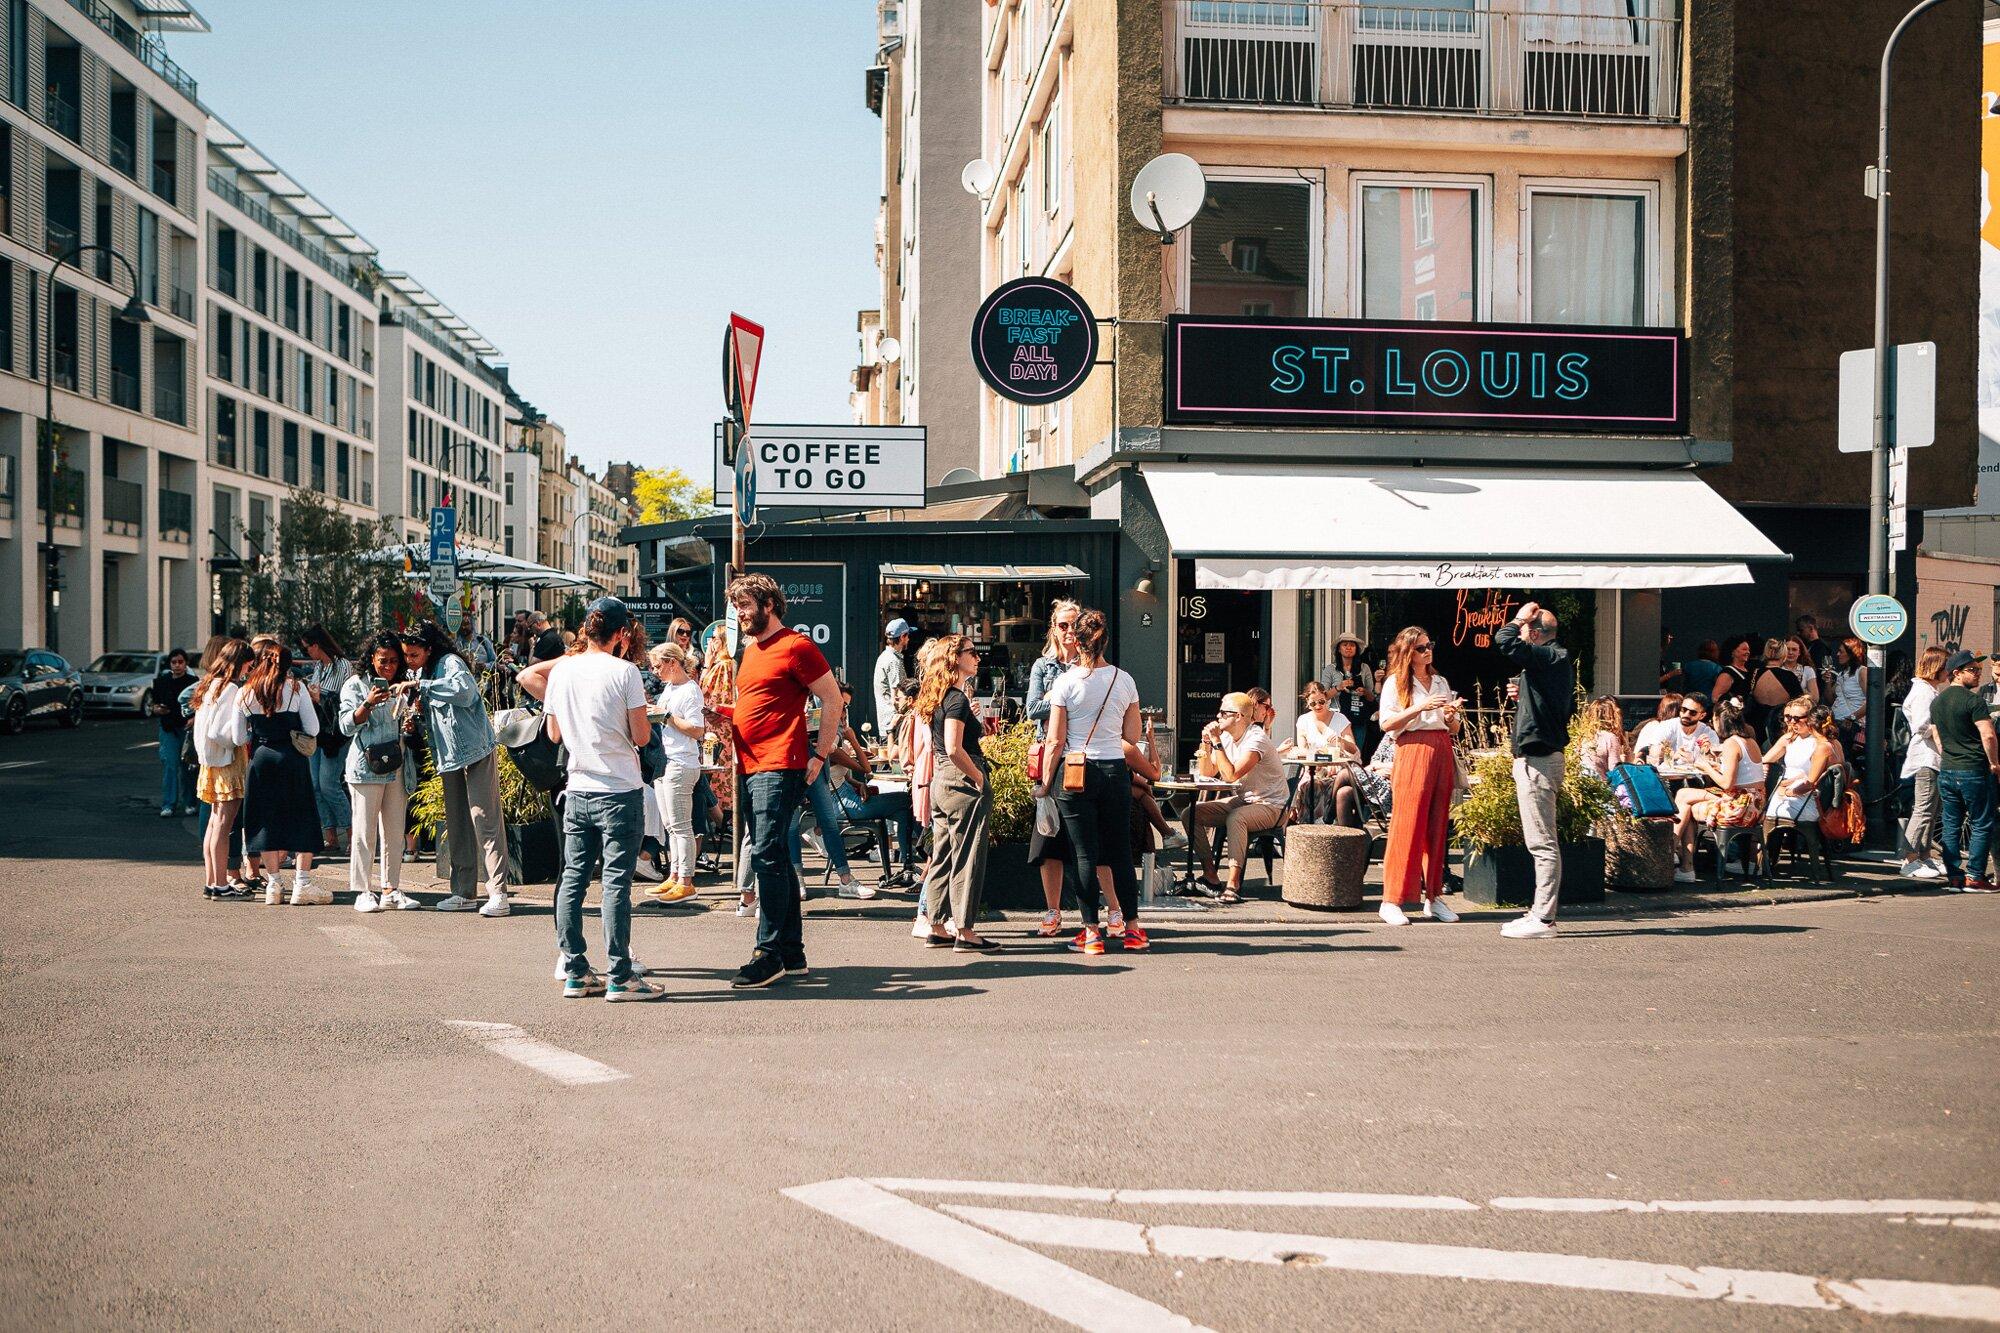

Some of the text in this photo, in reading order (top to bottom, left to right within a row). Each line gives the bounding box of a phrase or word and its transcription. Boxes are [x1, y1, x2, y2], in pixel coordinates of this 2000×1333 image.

[999, 308, 1078, 326] BREAK-
[1007, 326, 1061, 344] FAST
[1013, 345, 1054, 362] ALL
[1010, 363, 1058, 380] DAY!
[1270, 346, 1589, 400] ST. LOUIS
[760, 443, 880, 464] COFFEE
[774, 469, 866, 489] TO GO
[1435, 562, 1502, 587] Breakfast
[649, 602, 660, 610] TO
[661, 602, 674, 610] GO
[1186, 691, 1221, 699] WELCOME
